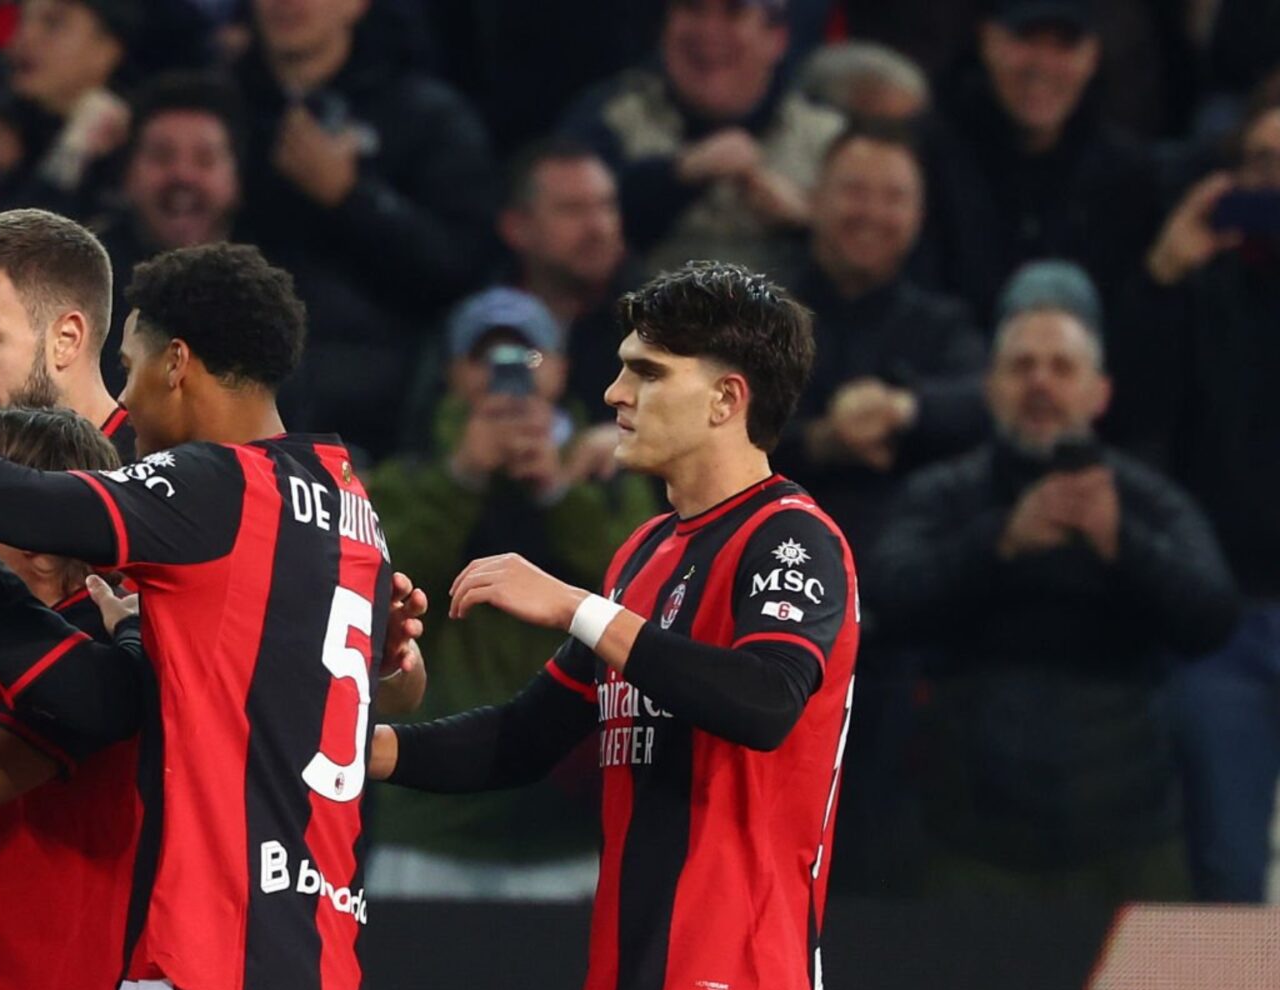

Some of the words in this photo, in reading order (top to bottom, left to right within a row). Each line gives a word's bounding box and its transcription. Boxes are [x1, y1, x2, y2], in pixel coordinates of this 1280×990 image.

[289, 476, 330, 531] DE
[750, 568, 824, 604] MSC
[302, 585, 372, 803] 5
